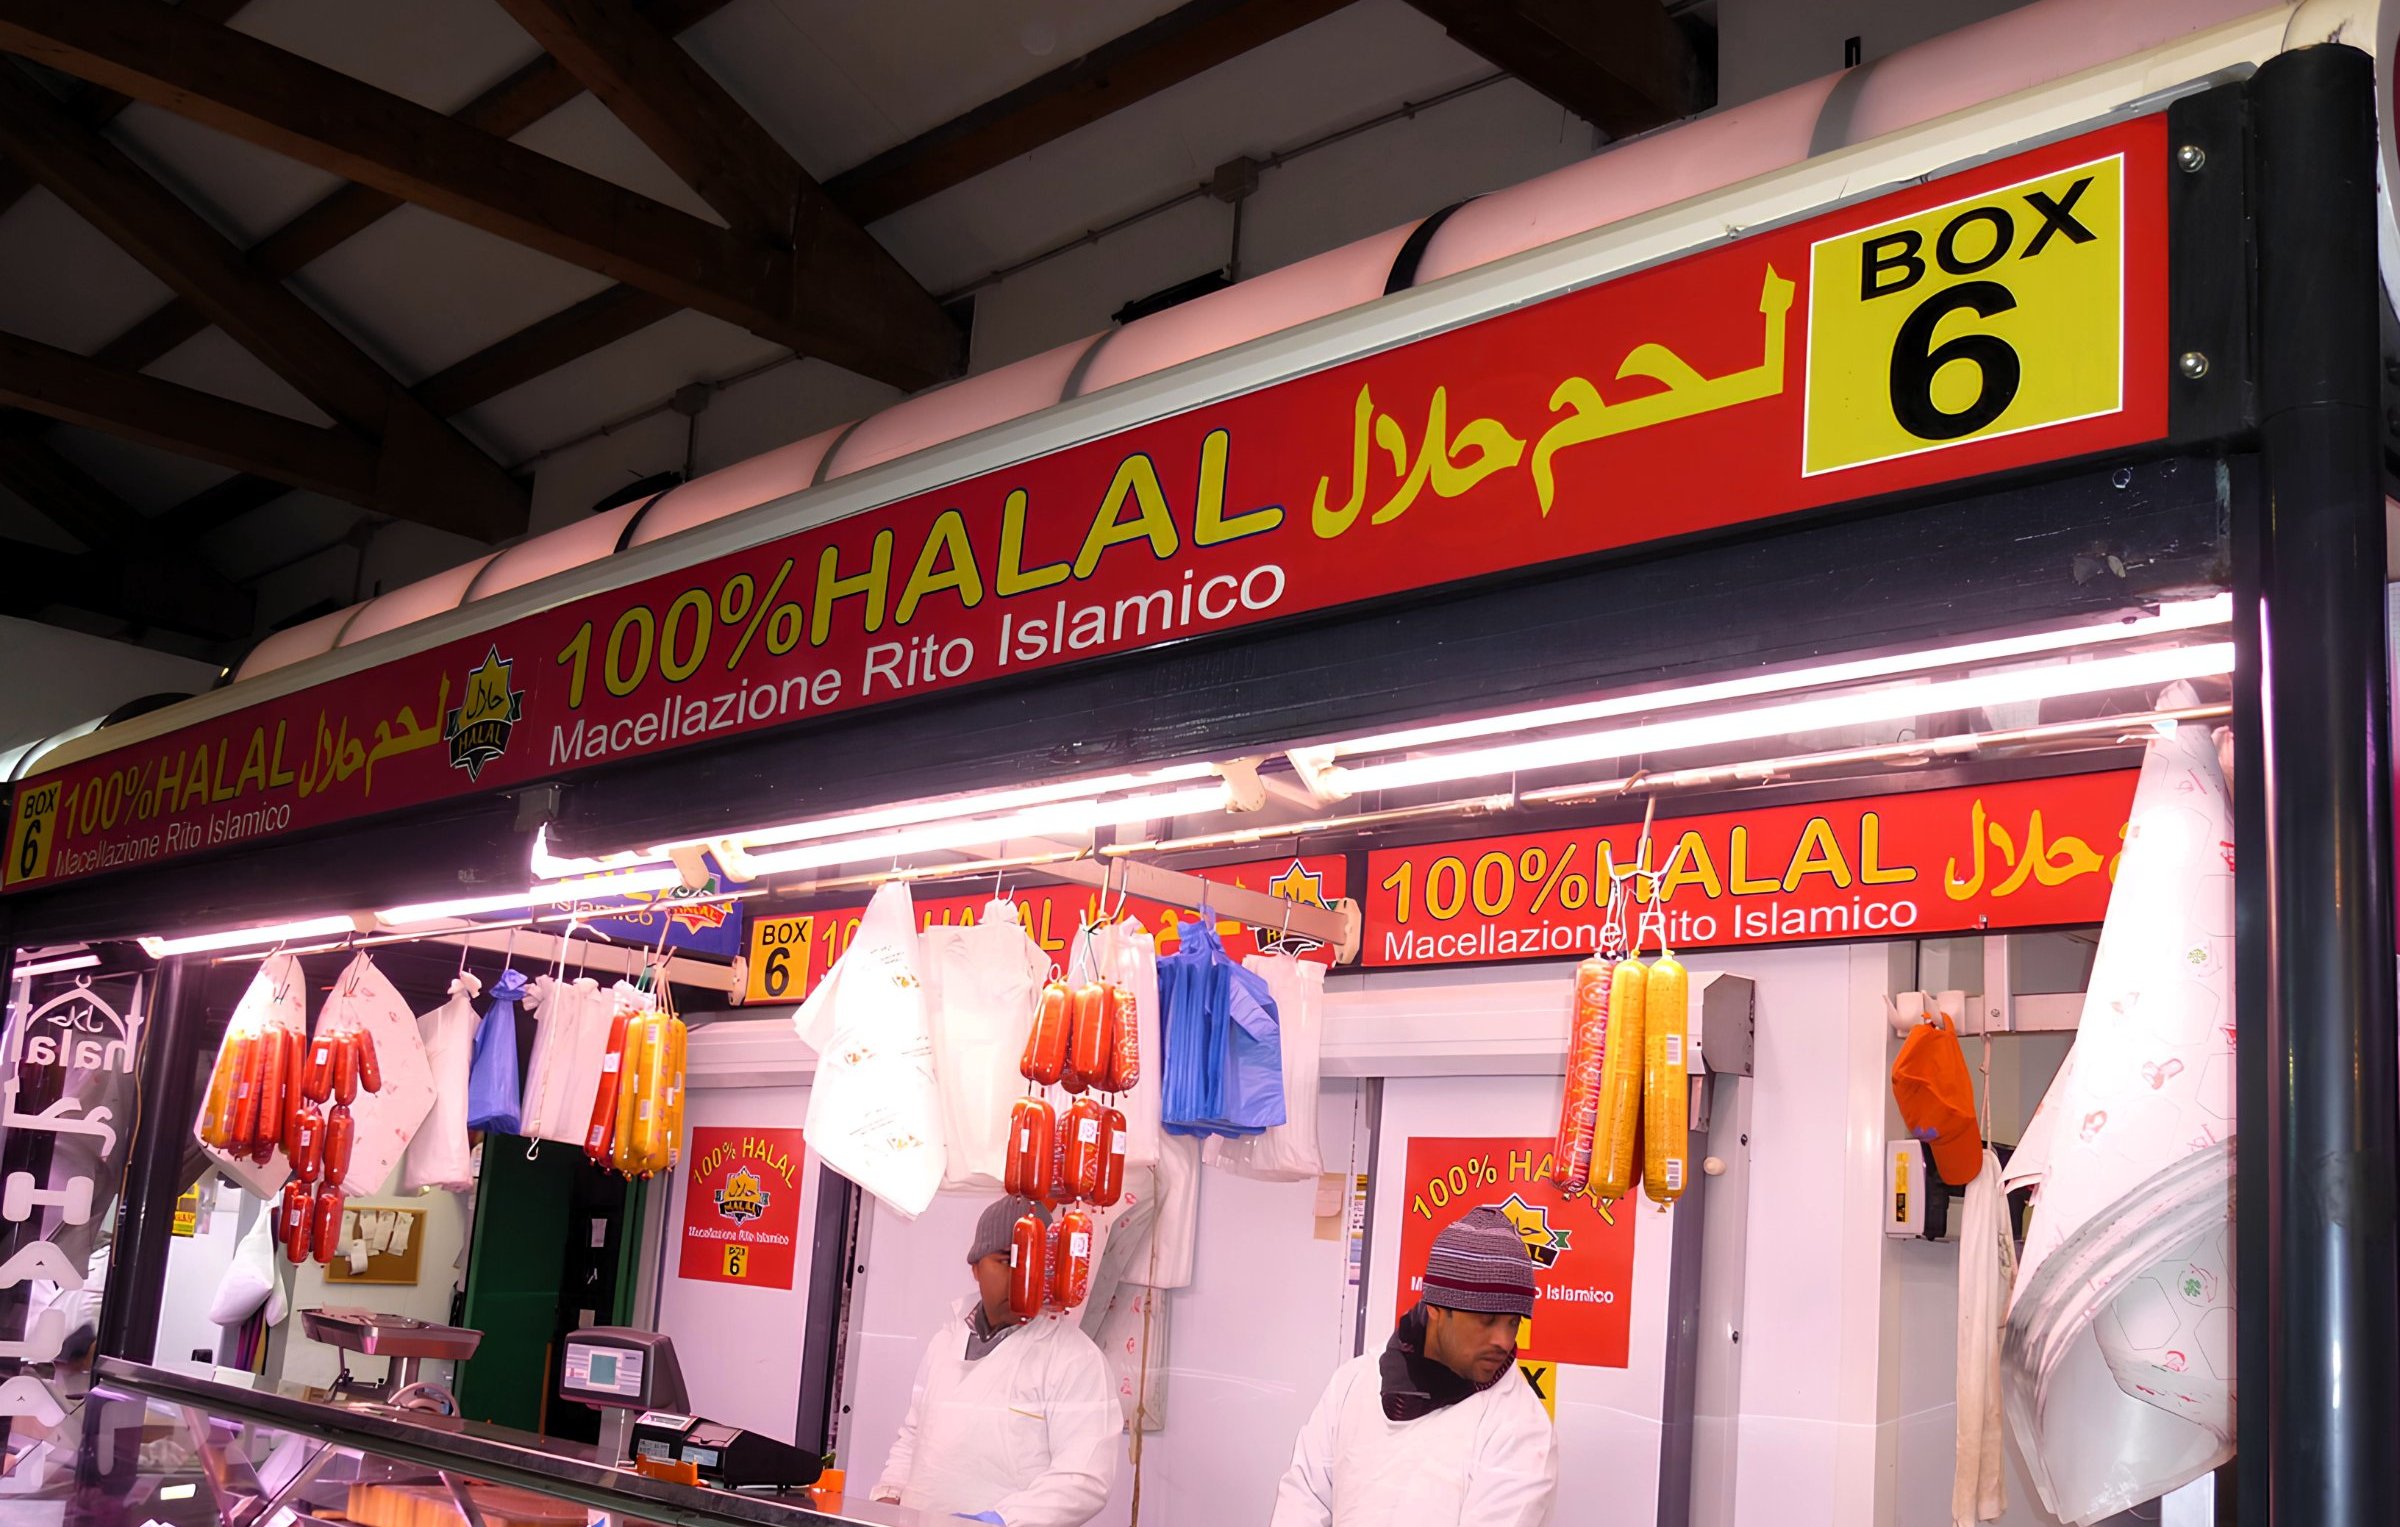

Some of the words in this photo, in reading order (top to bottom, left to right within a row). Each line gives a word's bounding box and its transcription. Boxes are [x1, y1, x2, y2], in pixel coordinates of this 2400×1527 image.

[1861, 176, 2098, 302] BOX
[1531, 262, 1796, 519] لحم
[1889, 280, 2021, 441] 6
[1311, 383, 1528, 540] حلال
[549, 661, 842, 767] Macellazione
[862, 635, 973, 696] Rito
[997, 564, 1286, 666] Islamico
[300, 709, 366, 798] حلال
[365, 669, 450, 797] لحم
[24, 786, 58, 819] BOX
[20, 819, 41, 878] 6
[54, 834, 160, 878] Macellazione
[164, 821, 201, 854] Rito
[207, 801, 290, 845] Islamico
[1944, 799, 2104, 900] حلال
[762, 921, 808, 945] BOX
[1385, 920, 1622, 961] Macellazione
[1734, 896, 1918, 938] Islamico
[764, 947, 791, 997] 6
[693, 1141, 737, 1185] 100%
[742, 1137, 796, 1189] HALAL
[1412, 1154, 1498, 1221] 100%
[729, 1255, 741, 1276] 6
[1546, 1283, 1615, 1304] Islamico
